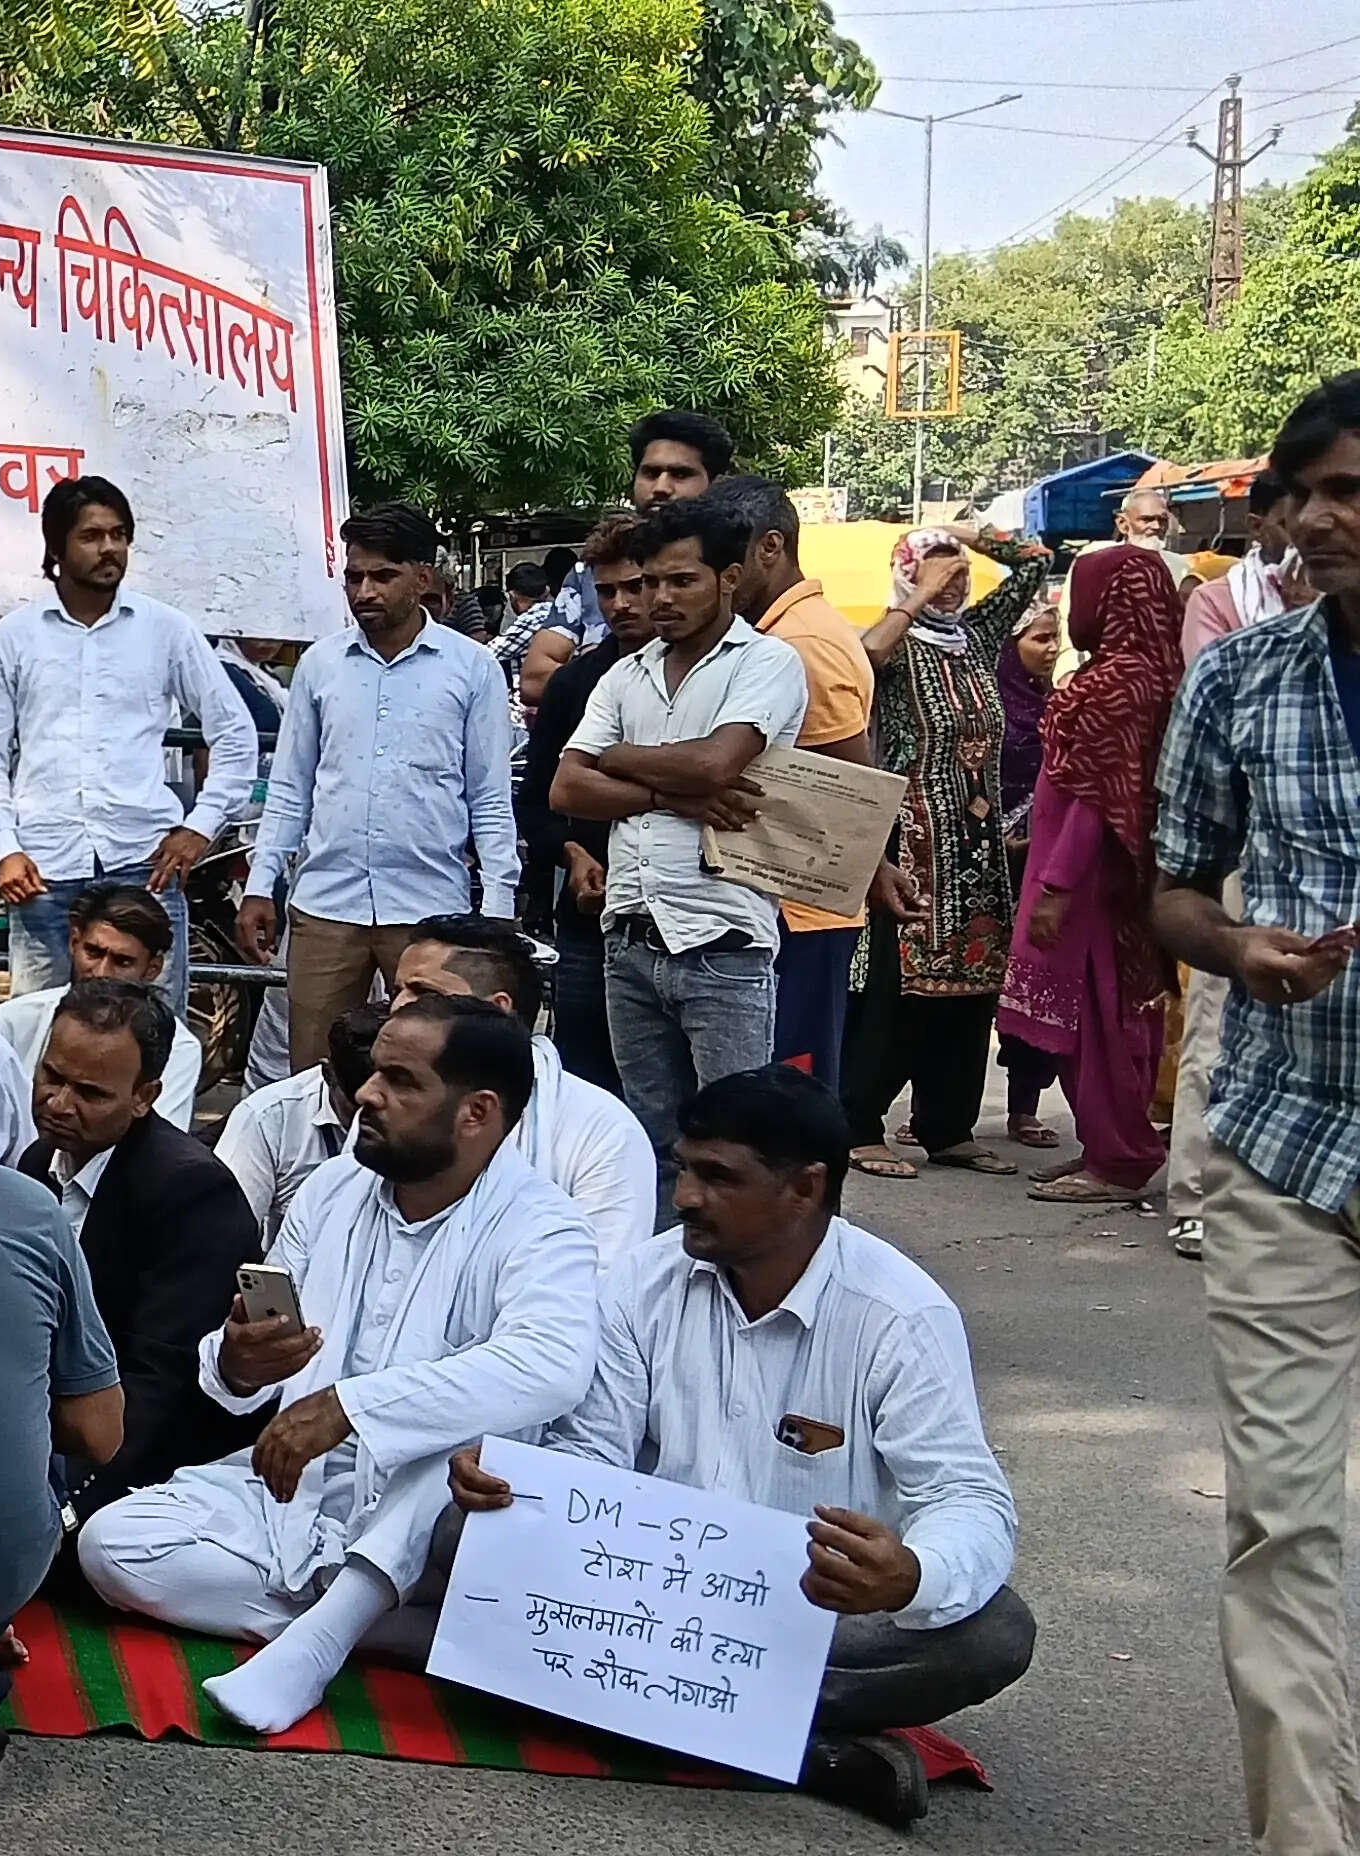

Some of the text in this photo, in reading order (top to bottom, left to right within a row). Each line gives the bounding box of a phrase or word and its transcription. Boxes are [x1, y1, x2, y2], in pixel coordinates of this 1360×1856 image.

[54, 194, 297, 413] चिकित्सालय
[567, 1488, 622, 1528] DM
[668, 1518, 729, 1550] SP
[579, 1539, 653, 1582] होश
[700, 1569, 771, 1607] आओ
[670, 1616, 703, 1653] की
[710, 1633, 768, 1670] हत्या
[532, 1647, 575, 1679] पर
[642, 1674, 739, 1714] लगाओ
